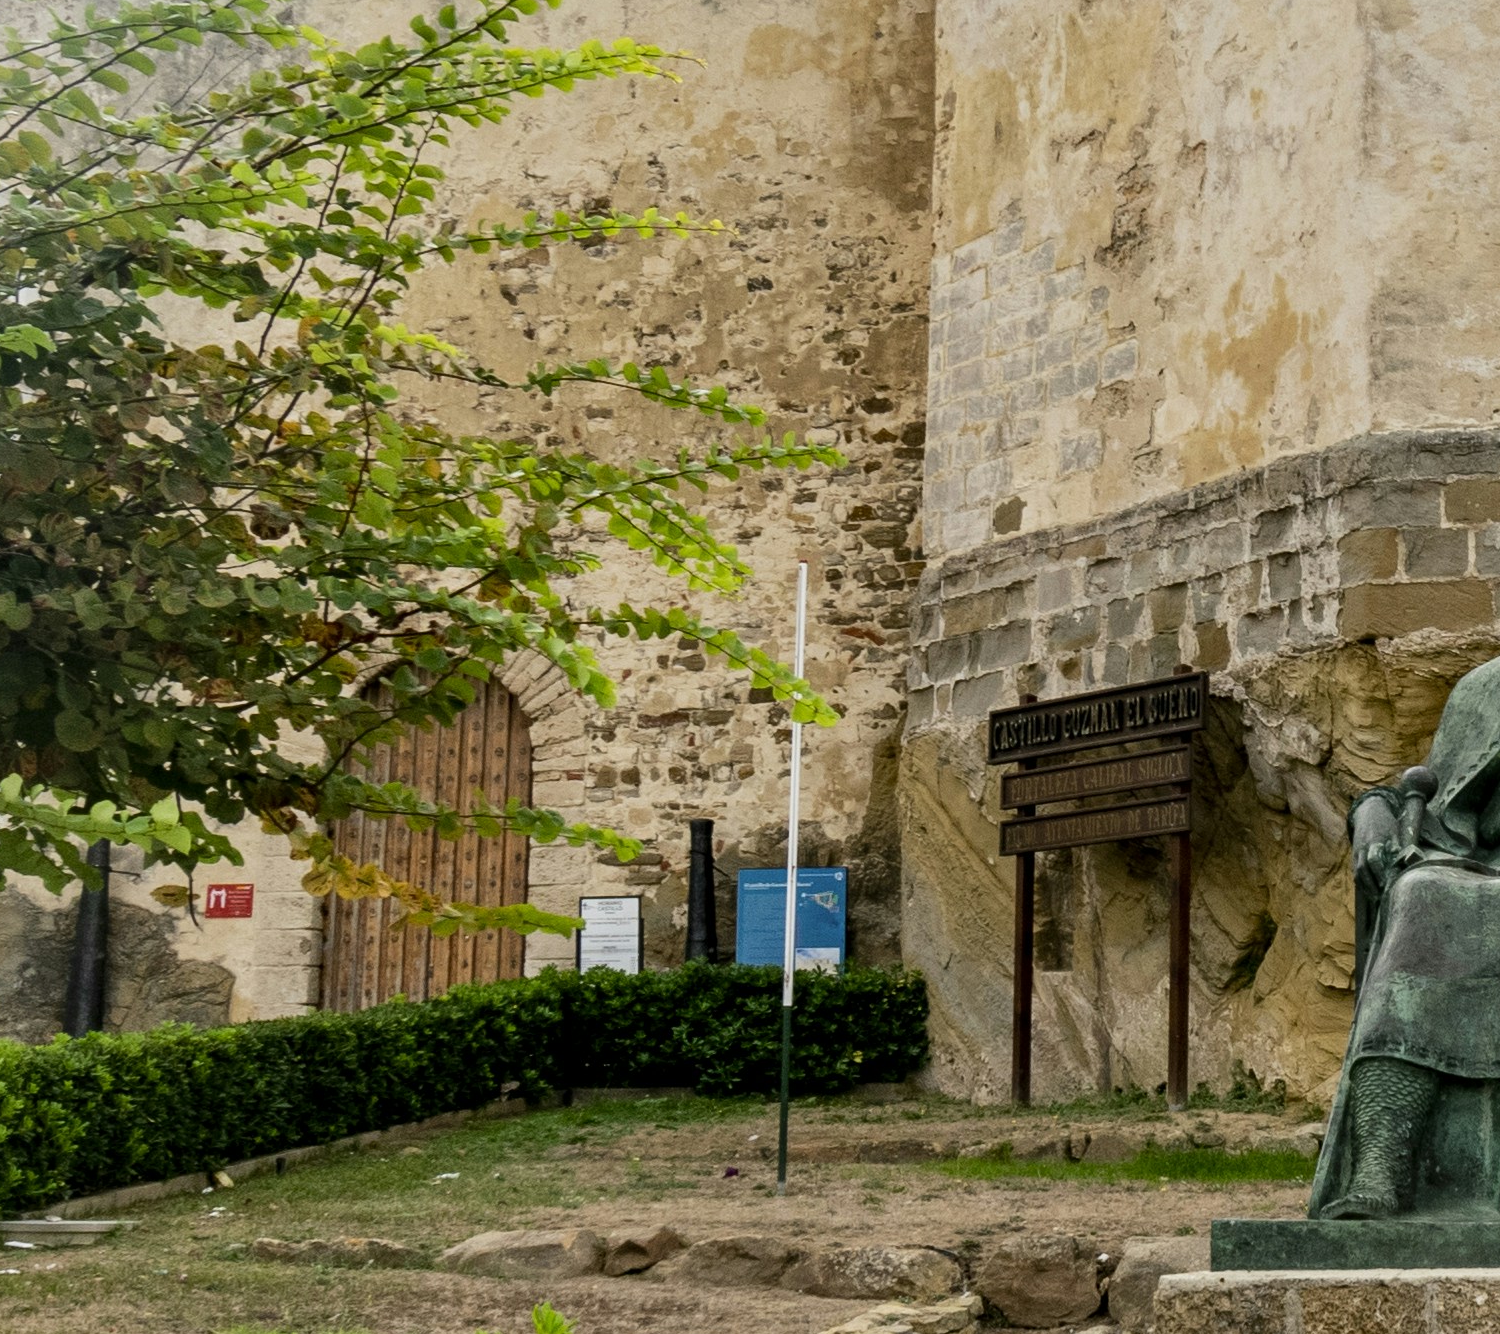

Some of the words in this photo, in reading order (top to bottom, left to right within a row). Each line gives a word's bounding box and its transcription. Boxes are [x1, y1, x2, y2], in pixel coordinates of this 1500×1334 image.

[993, 713, 1056, 750] CASTILLO
[1063, 700, 1120, 738] GUZMAN
[1126, 696, 1144, 727] EL
[1150, 687, 1199, 723] BUENO
